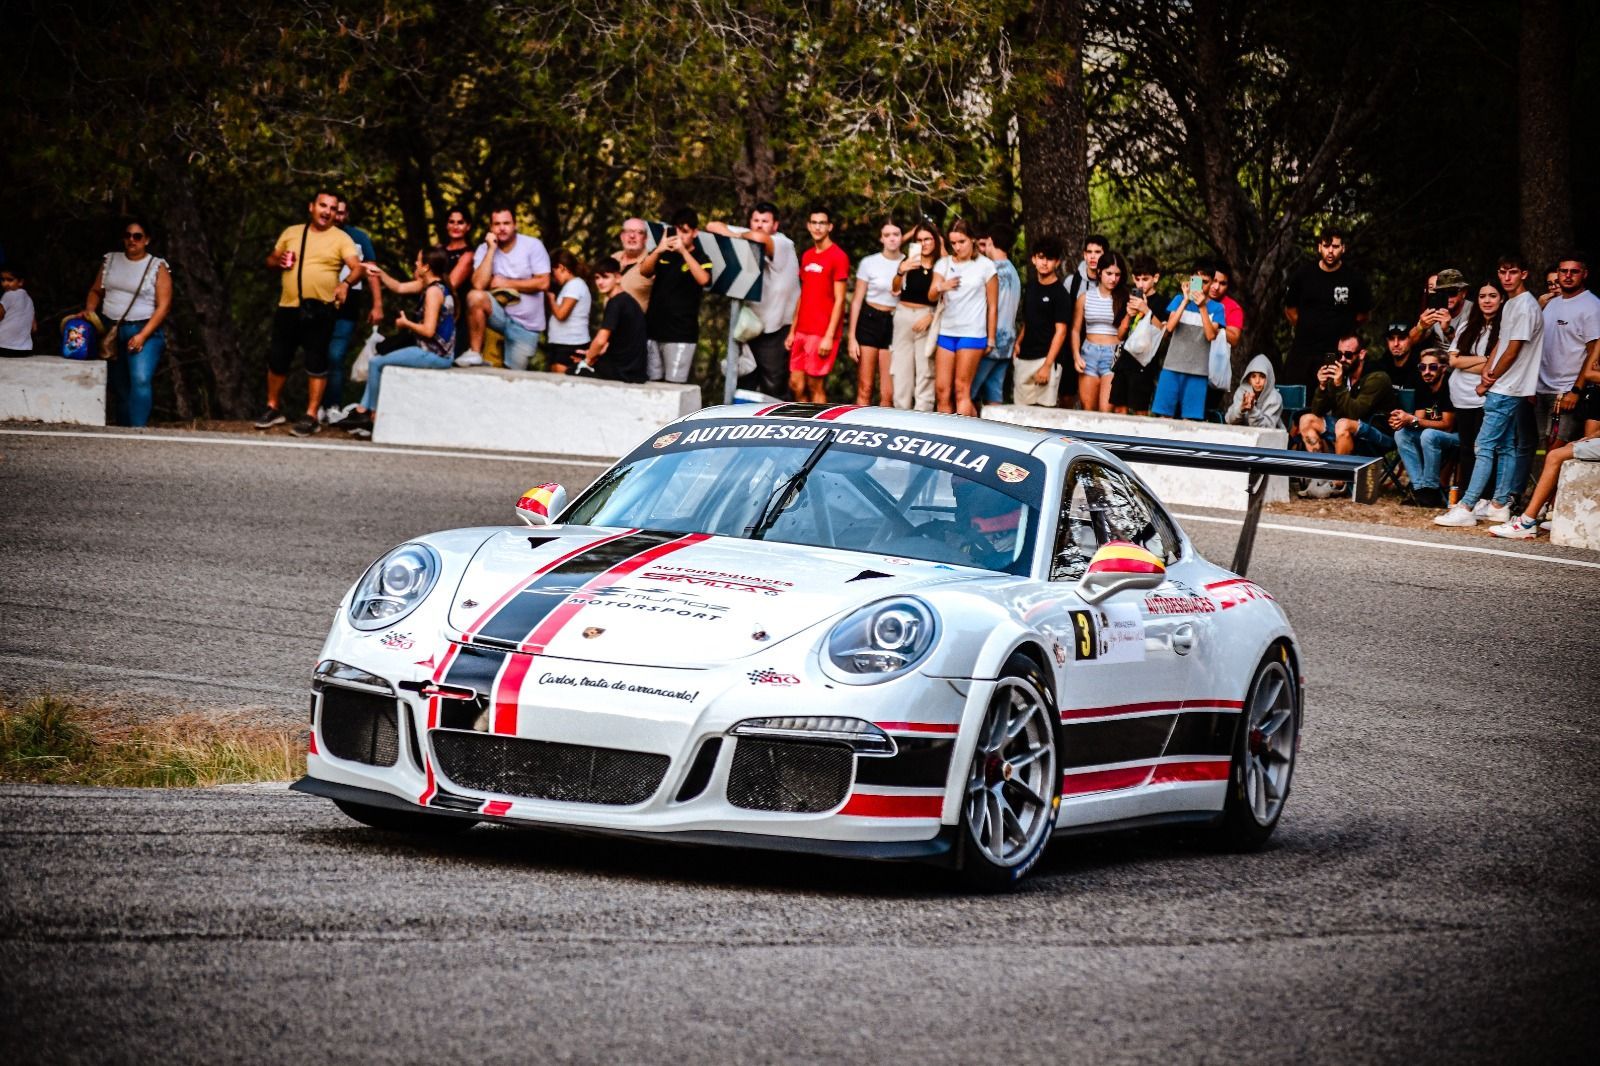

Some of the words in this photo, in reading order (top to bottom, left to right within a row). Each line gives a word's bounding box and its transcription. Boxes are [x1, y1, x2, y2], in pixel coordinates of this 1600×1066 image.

[887, 435, 990, 473] SEVILLA
[638, 572, 758, 594] SEVILLA
[652, 564, 794, 587] AUTODESGUACES
[567, 598, 722, 621] MOTORSPORT
[1144, 596, 1216, 614] AUTODESGUACES
[1076, 612, 1092, 657] 3
[538, 672, 577, 687] Carlos,
[579, 675, 609, 690] trata
[610, 679, 627, 692] de
[627, 683, 700, 703] arrancarlo!
